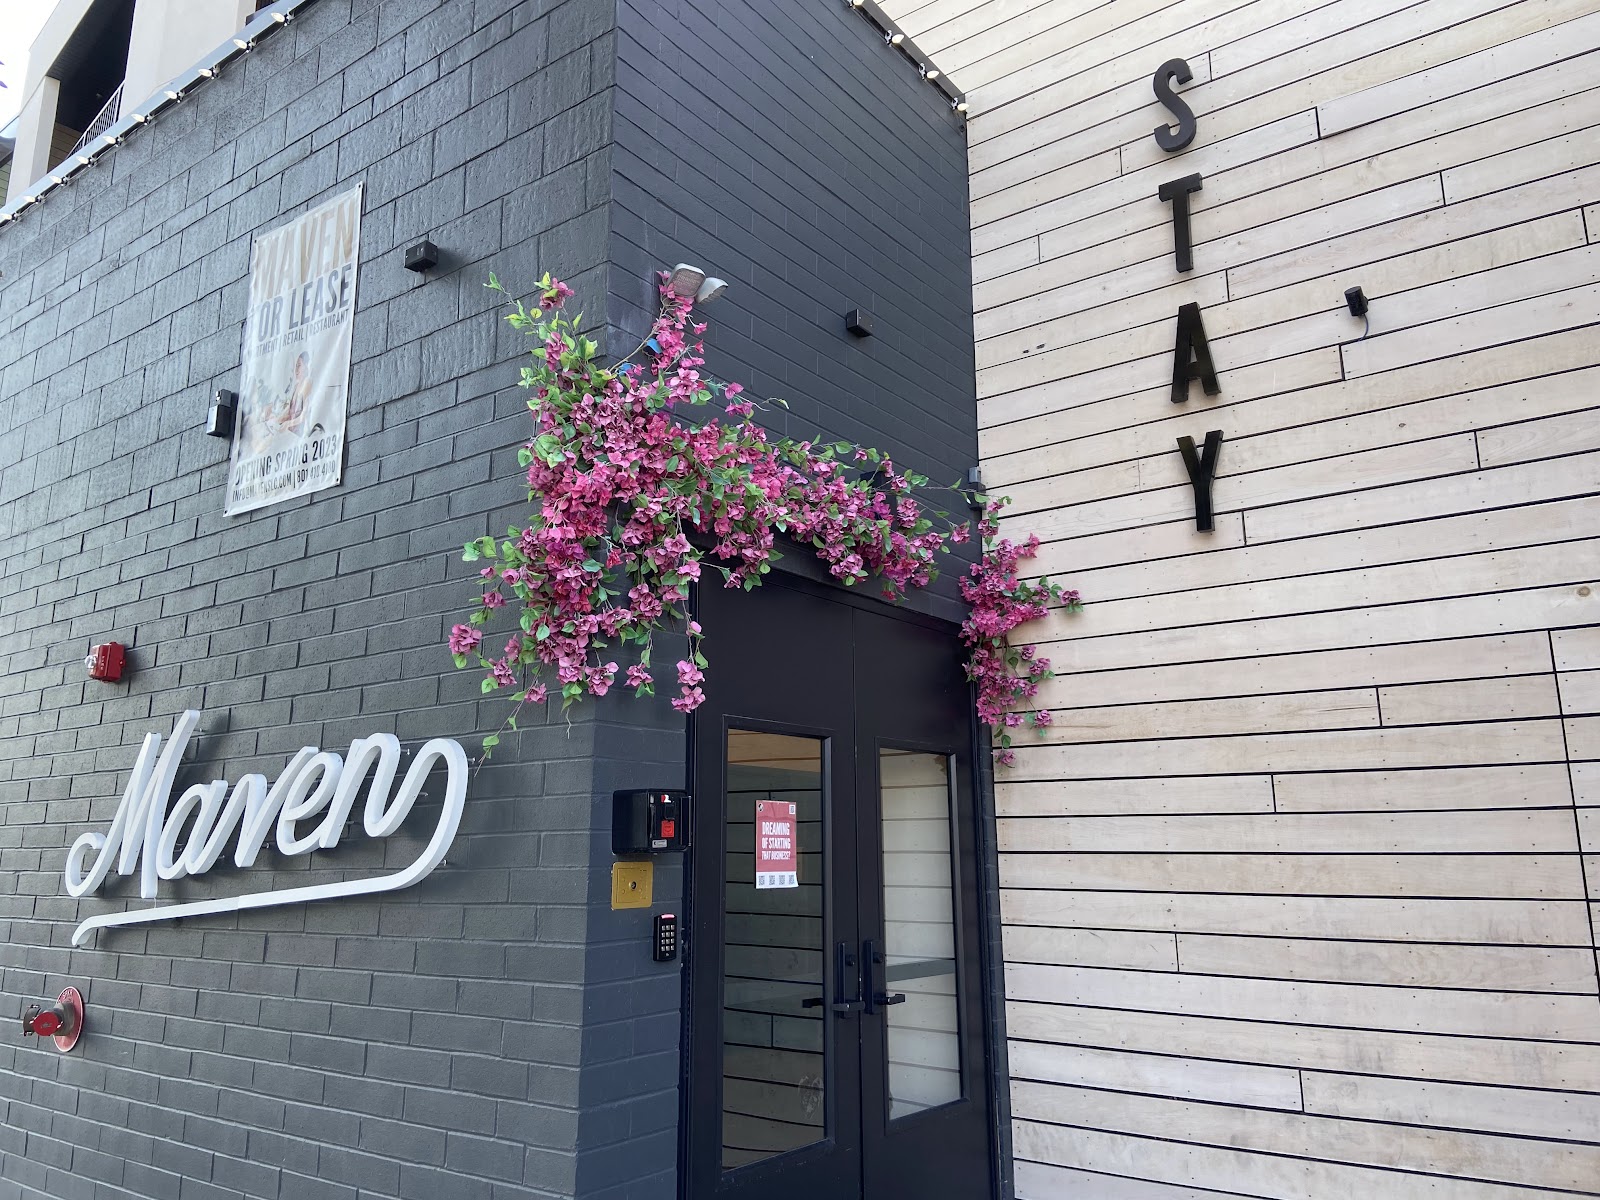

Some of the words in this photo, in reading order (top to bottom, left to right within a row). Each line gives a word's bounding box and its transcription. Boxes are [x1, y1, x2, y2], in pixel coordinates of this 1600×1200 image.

[253, 199, 355, 302] MAVEN
[254, 294, 284, 345] OR
[289, 263, 351, 330] LEASE
[1153, 57, 1224, 534] STAY
[282, 331, 304, 347] RETAIL
[309, 308, 350, 336] RESTAURANT
[235, 455, 272, 486] OPENING
[275, 443, 308, 473] SPRING
[312, 434, 337, 462] 2023
[65, 709, 470, 946] Maven
[762, 822, 790, 835] DREAMING
[762, 838, 768, 849] OF
[769, 838, 790, 849] STARTING
[762, 851, 771, 860] THAT
